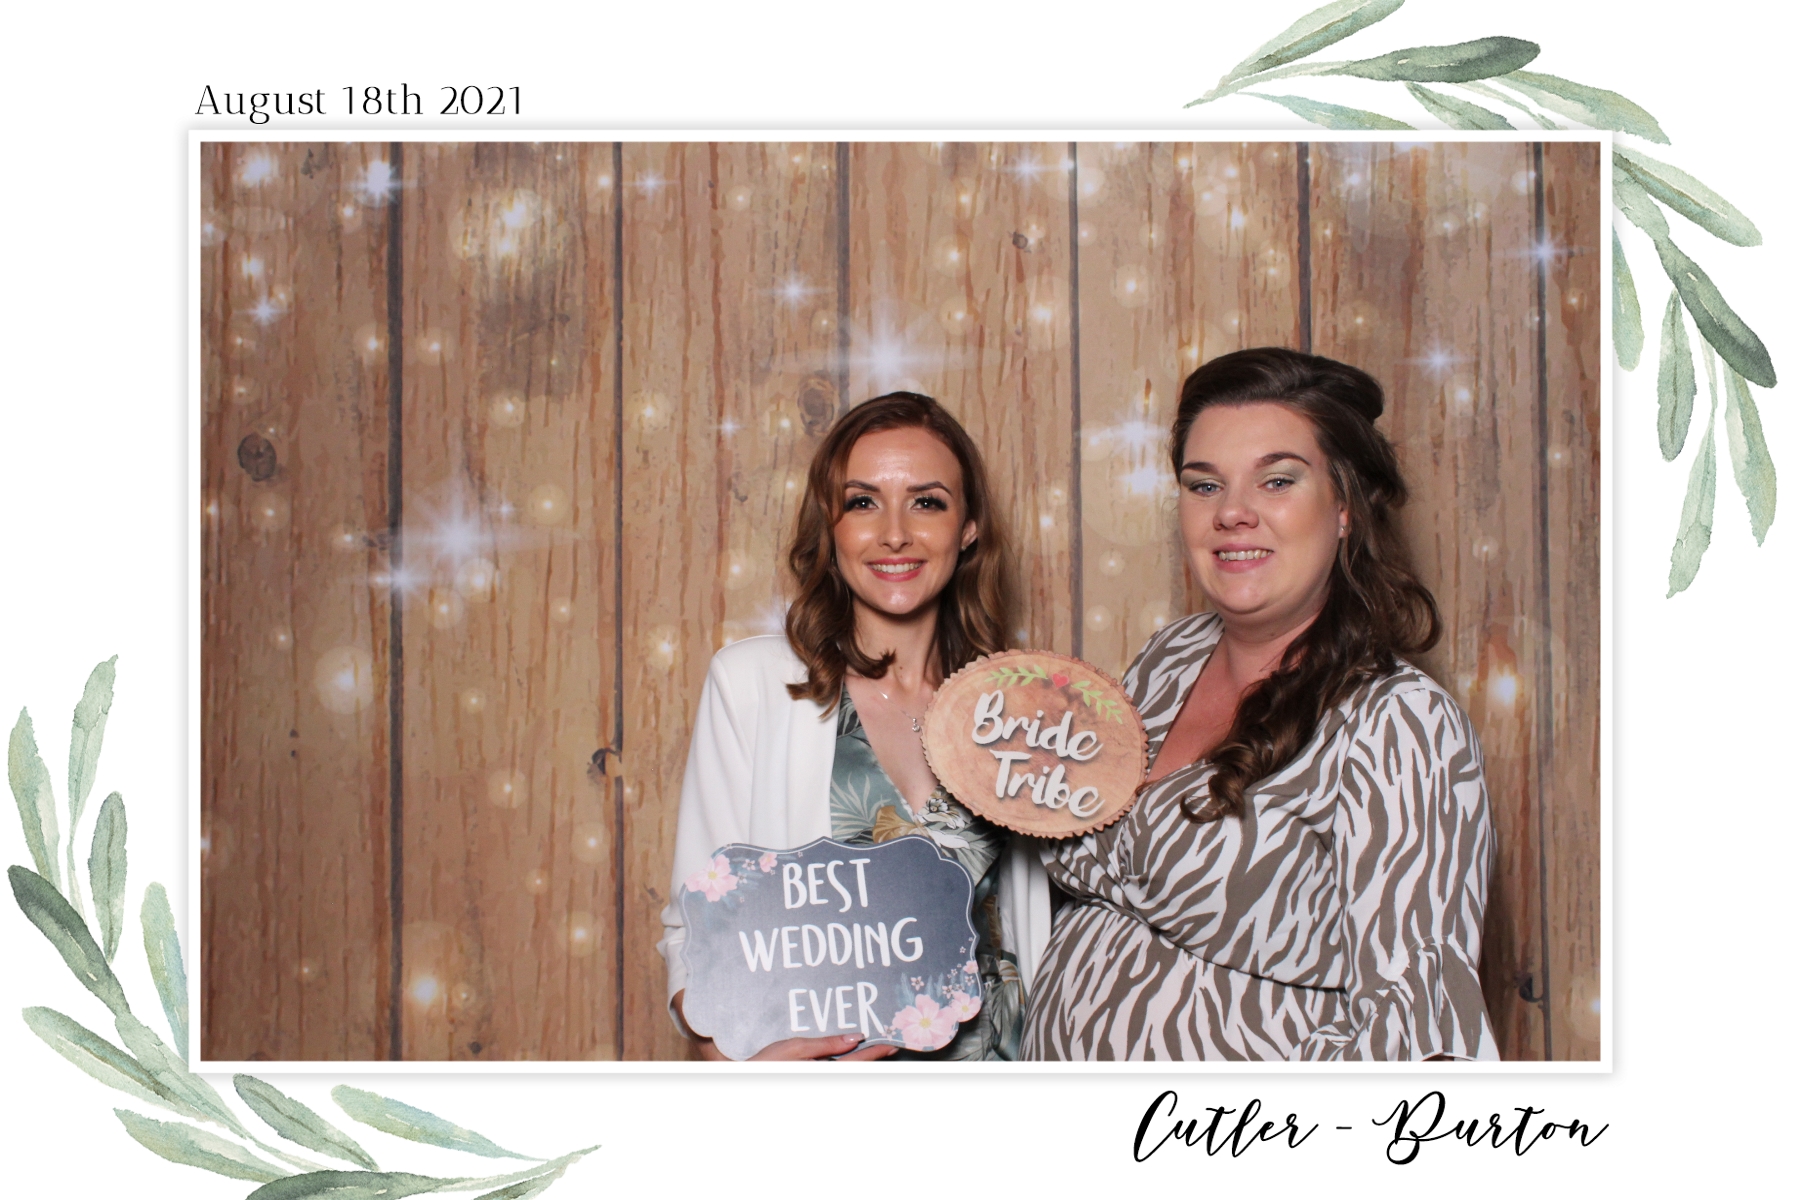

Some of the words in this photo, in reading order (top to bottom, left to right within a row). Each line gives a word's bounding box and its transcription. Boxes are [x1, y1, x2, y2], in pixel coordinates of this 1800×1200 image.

[971, 689, 1104, 761] Bride
[988, 748, 1106, 818] Tribe
[782, 858, 871, 913] BEST
[738, 917, 924, 973] WEDDING
[788, 981, 886, 1038] EVER
